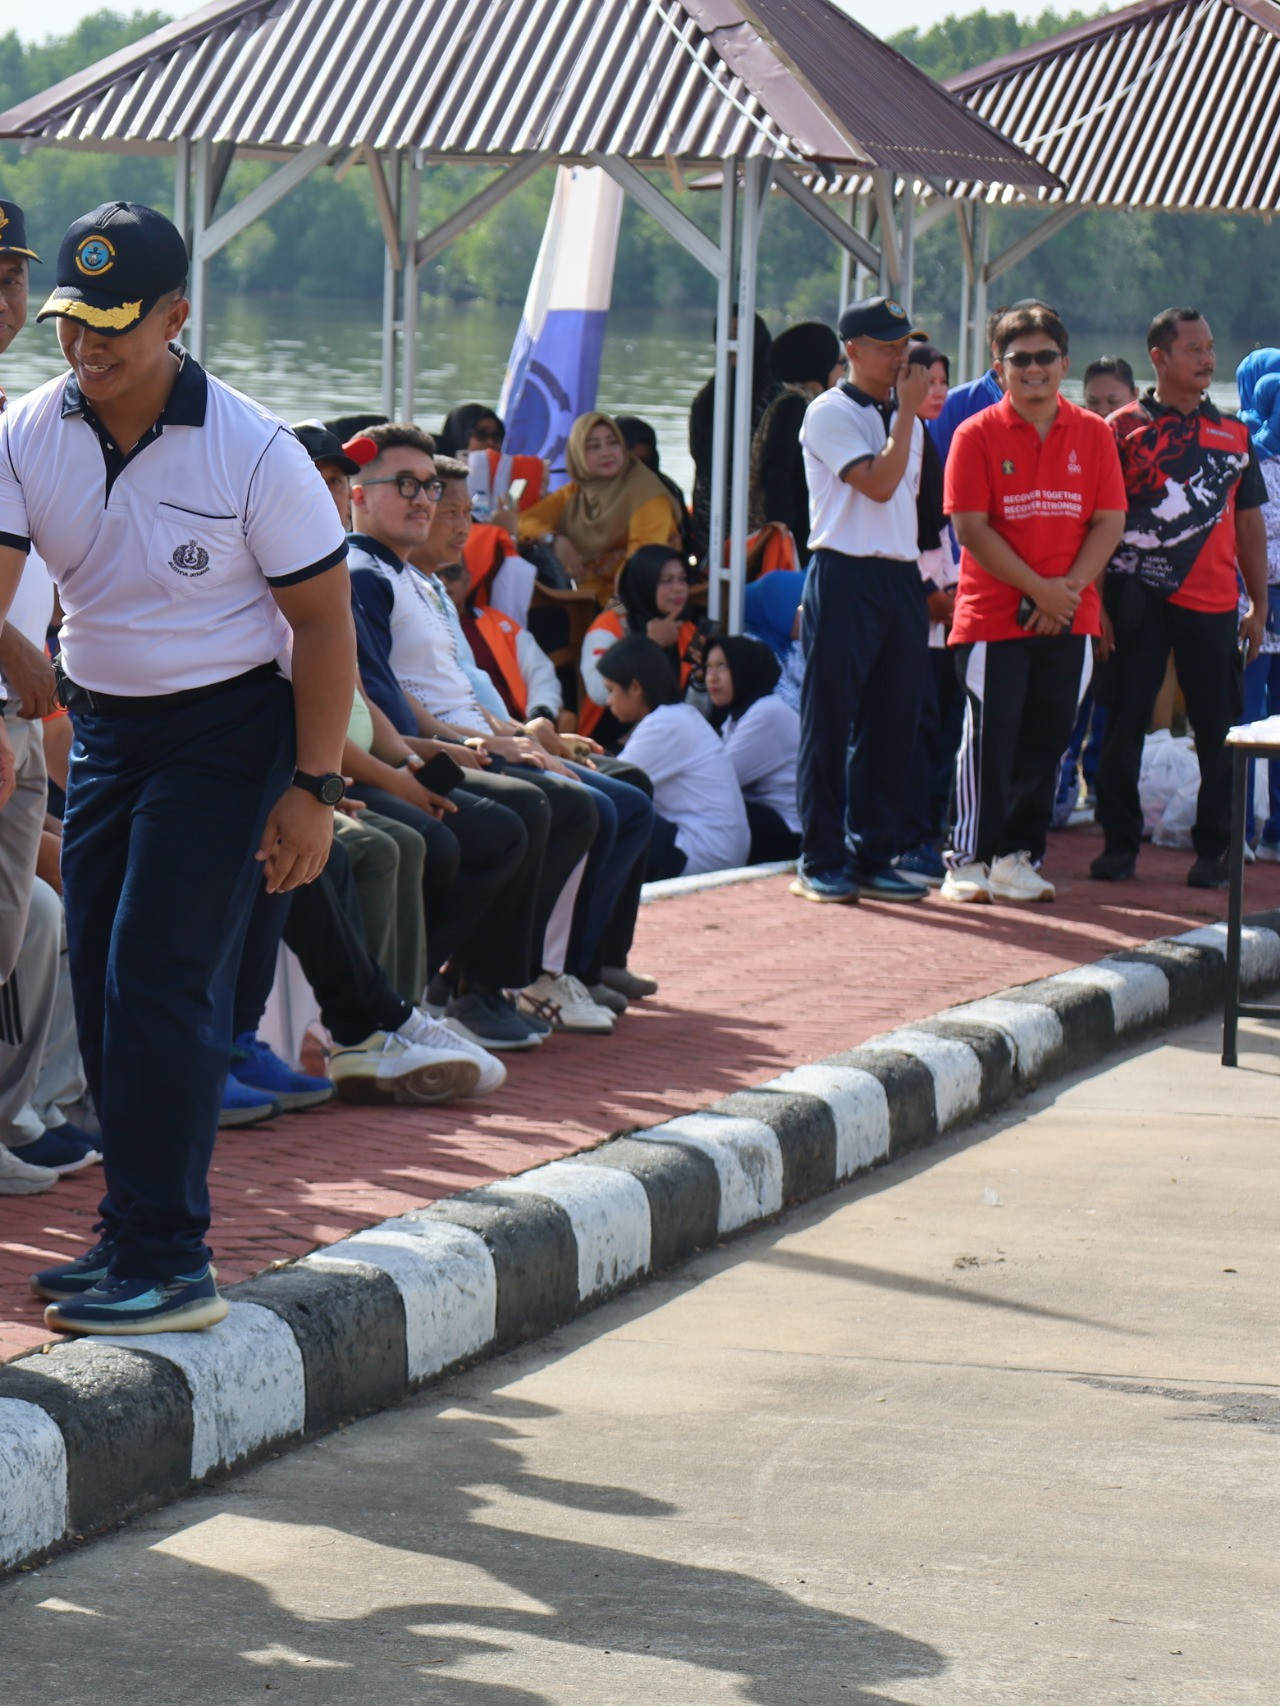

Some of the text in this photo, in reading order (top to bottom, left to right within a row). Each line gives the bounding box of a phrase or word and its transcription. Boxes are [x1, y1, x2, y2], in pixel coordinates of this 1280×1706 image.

[1003, 489, 1082, 504] RECOVER TOGETHER
[1004, 500, 1082, 514] RECOVER STRONGER
